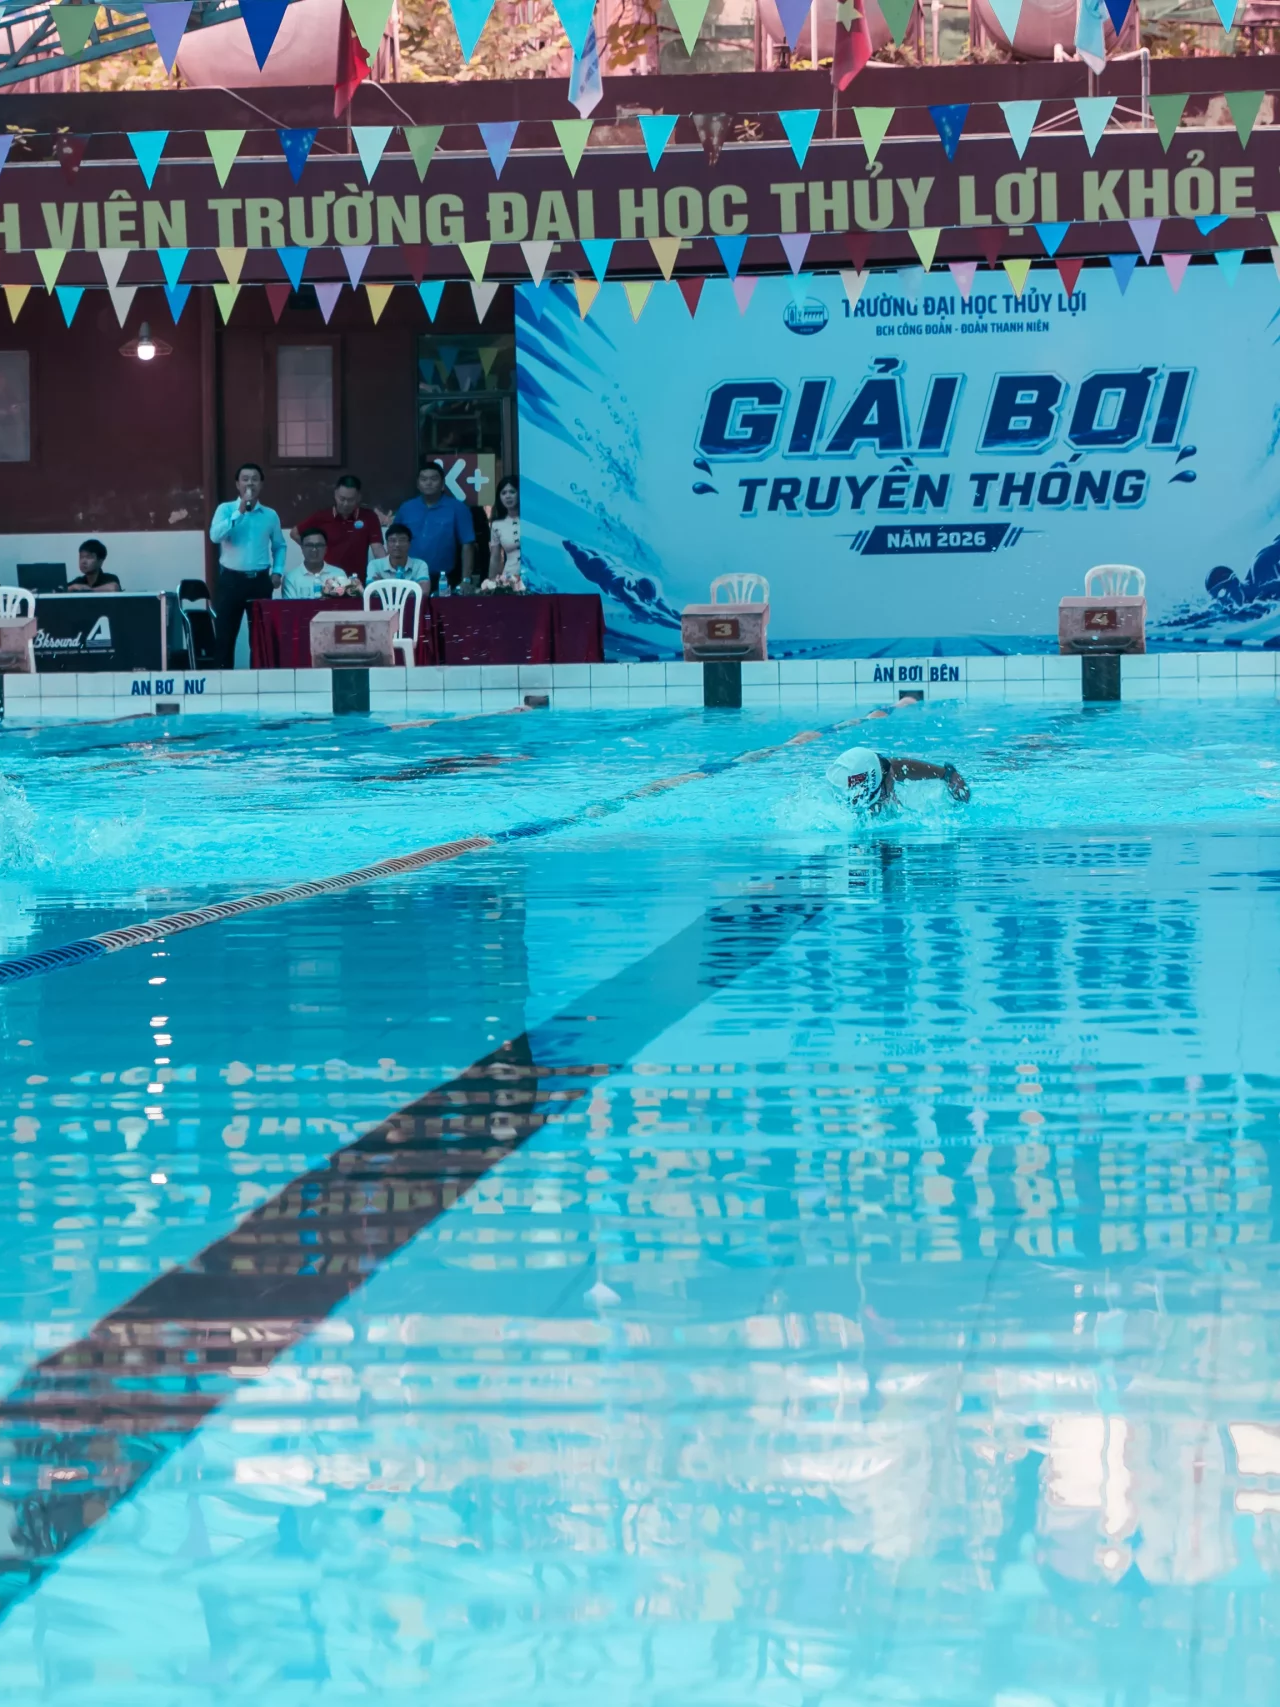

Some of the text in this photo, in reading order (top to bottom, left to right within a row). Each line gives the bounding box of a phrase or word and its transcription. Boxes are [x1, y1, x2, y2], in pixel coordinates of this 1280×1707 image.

[40, 189, 187, 252] VIÊN
[207, 183, 466, 248] TRƯỜNG
[486, 189, 595, 252] ĐẠI
[618, 184, 748, 250] HỌC
[770, 161, 935, 234] THỦY
[959, 167, 1057, 236] LỢI
[1083, 149, 1256, 222] KHỎE
[923, 296, 955, 320] ĐẠI
[961, 294, 997, 320] HỌC
[1002, 287, 1052, 314] THỦY
[1058, 290, 1086, 317] LỢI
[875, 325, 895, 336] BCH
[897, 322, 923, 336] CÔNG
[925, 321, 952, 335] ĐOÀN
[961, 321, 988, 334] ĐOÀN
[990, 322, 1024, 333] THANH
[1026, 319, 1049, 332] NIÊN
[696, 356, 1195, 459] GIẢI BƠI
[738, 453, 1148, 513] TRUYỀN THỐNG
[886, 529, 987, 548] NĂM 2026
[1090, 612, 1109, 625] 4
[341, 627, 359, 640] 2
[714, 623, 732, 636] 3
[898, 664, 923, 681] BƠI
[930, 664, 959, 681] BÊN
[131, 680, 151, 695] AN
